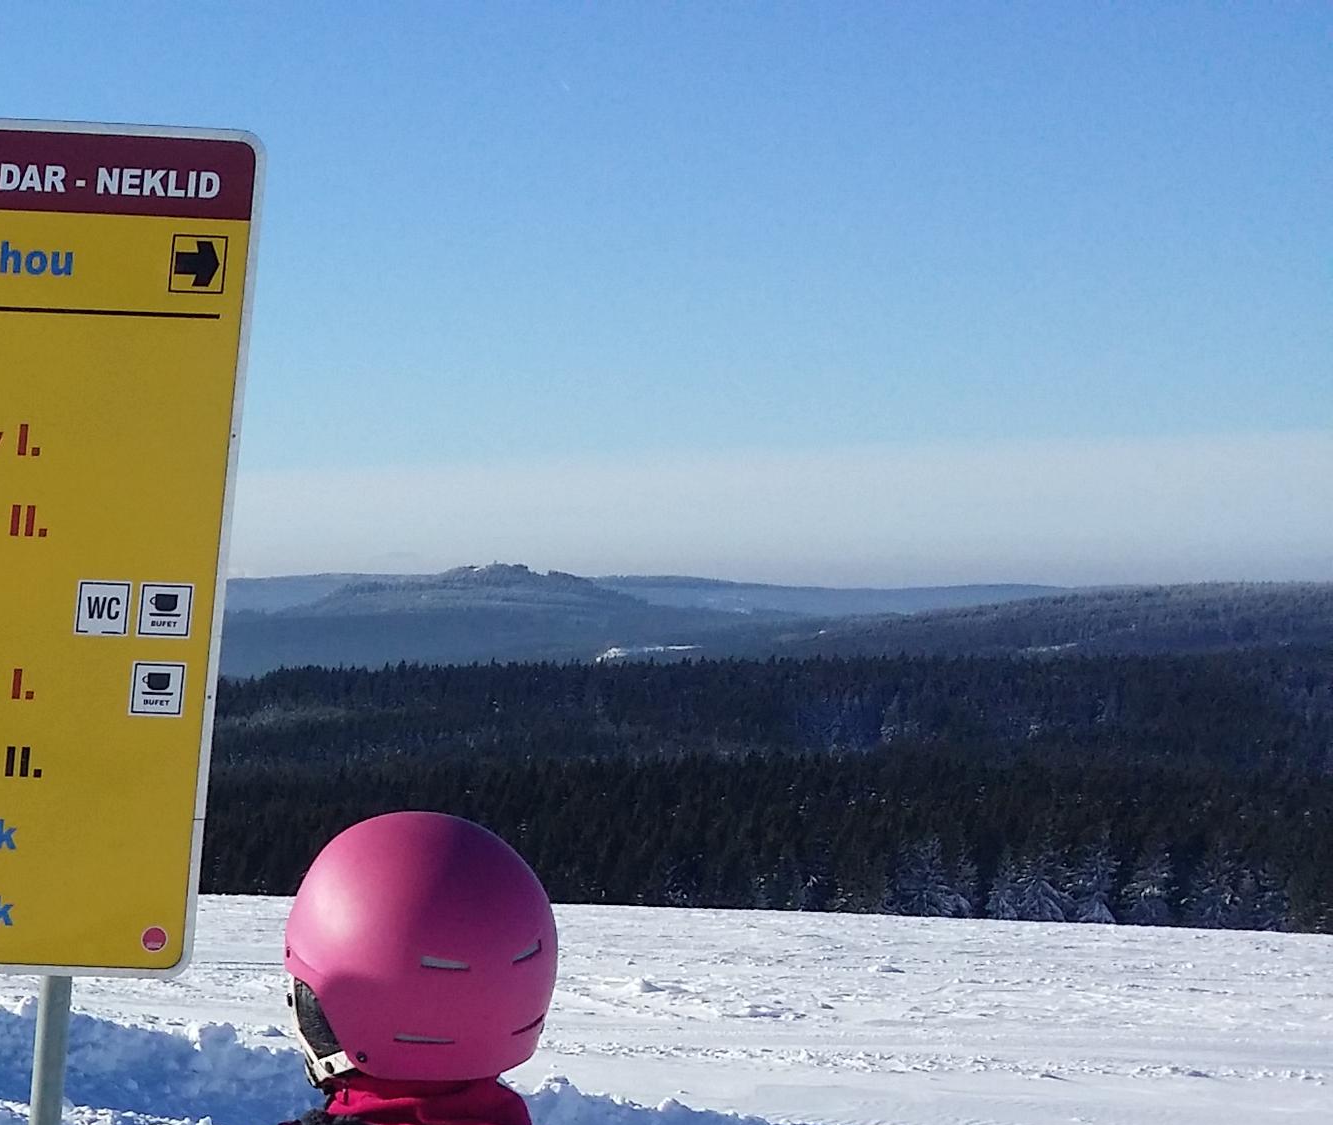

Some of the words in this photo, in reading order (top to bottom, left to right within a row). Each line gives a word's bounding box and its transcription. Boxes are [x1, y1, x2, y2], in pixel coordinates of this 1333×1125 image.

[0, 163, 66, 193] DAR
[96, 167, 220, 198] NEKLID
[9, 503, 48, 538] II.
[87, 596, 121, 620] WC
[150, 620, 177, 628] BUFET
[4, 746, 43, 779] II.
